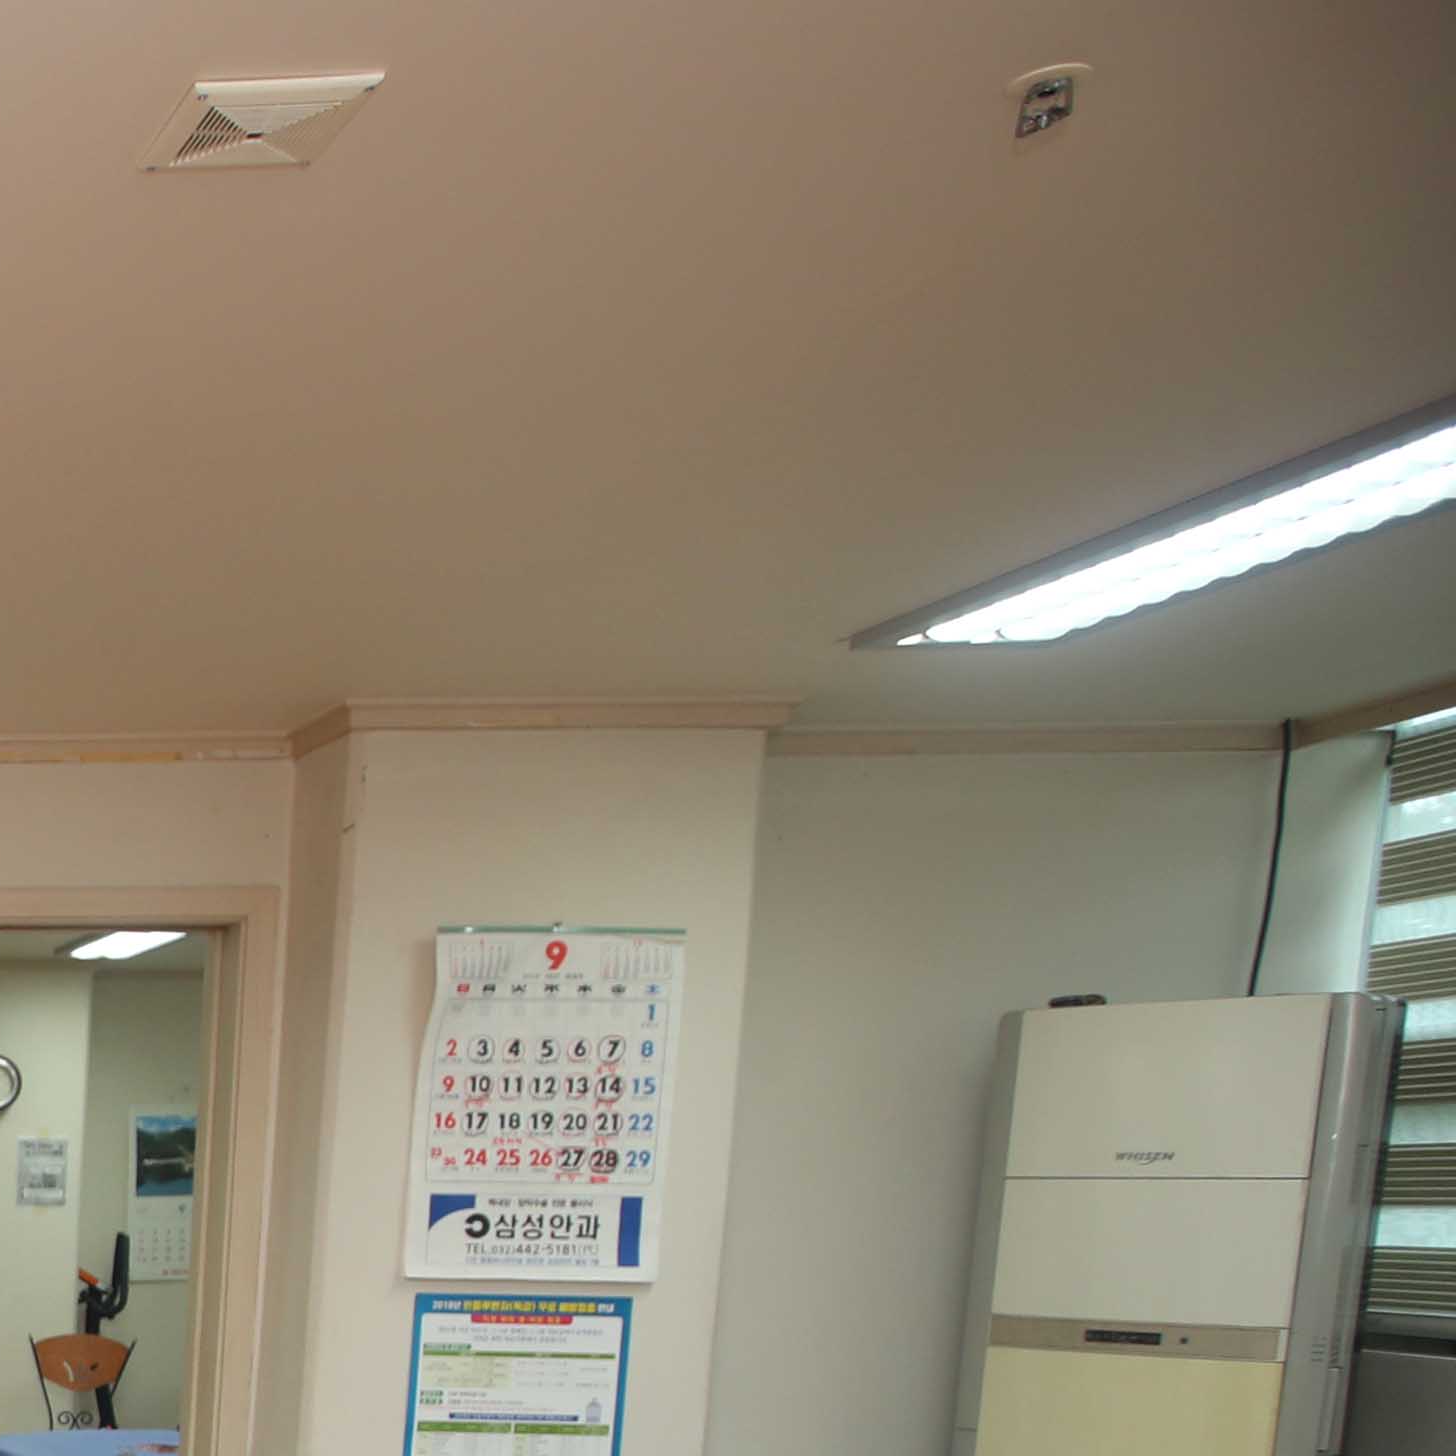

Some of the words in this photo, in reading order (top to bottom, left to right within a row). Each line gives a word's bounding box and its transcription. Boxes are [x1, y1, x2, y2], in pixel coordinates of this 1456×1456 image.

[545, 939, 568, 971] 9
[648, 1003, 656, 1021] 1
[446, 1039, 457, 1057] 2
[476, 1039, 488, 1057] 3
[508, 1039, 521, 1057] 4
[541, 1039, 553, 1057] 5
[573, 1039, 586, 1057] 6
[607, 1040, 620, 1057] 7
[640, 1040, 654, 1057] 8
[442, 1076, 455, 1093] 9
[470, 1075, 491, 1093] 10
[503, 1075, 523, 1093] 11
[533, 1075, 555, 1094] 12
[566, 1076, 588, 1094] 13
[599, 1076, 622, 1094] 14
[633, 1077, 656, 1095] 15
[434, 1112, 456, 1129] 16
[466, 1112, 487, 1130] 17
[499, 1112, 520, 1130] 18
[531, 1112, 553, 1130] 19
[563, 1113, 586, 1131] 20
[597, 1114, 619, 1131] 21
[629, 1113, 653, 1131] 22
[464, 1148, 487, 1166] 24
[497, 1149, 520, 1167] 25
[529, 1149, 552, 1167] 26
[561, 1149, 584, 1167] 27
[592, 1150, 618, 1167] 28
[626, 1150, 650, 1167] 29
[494, 1213, 600, 1240] 삼성안과
